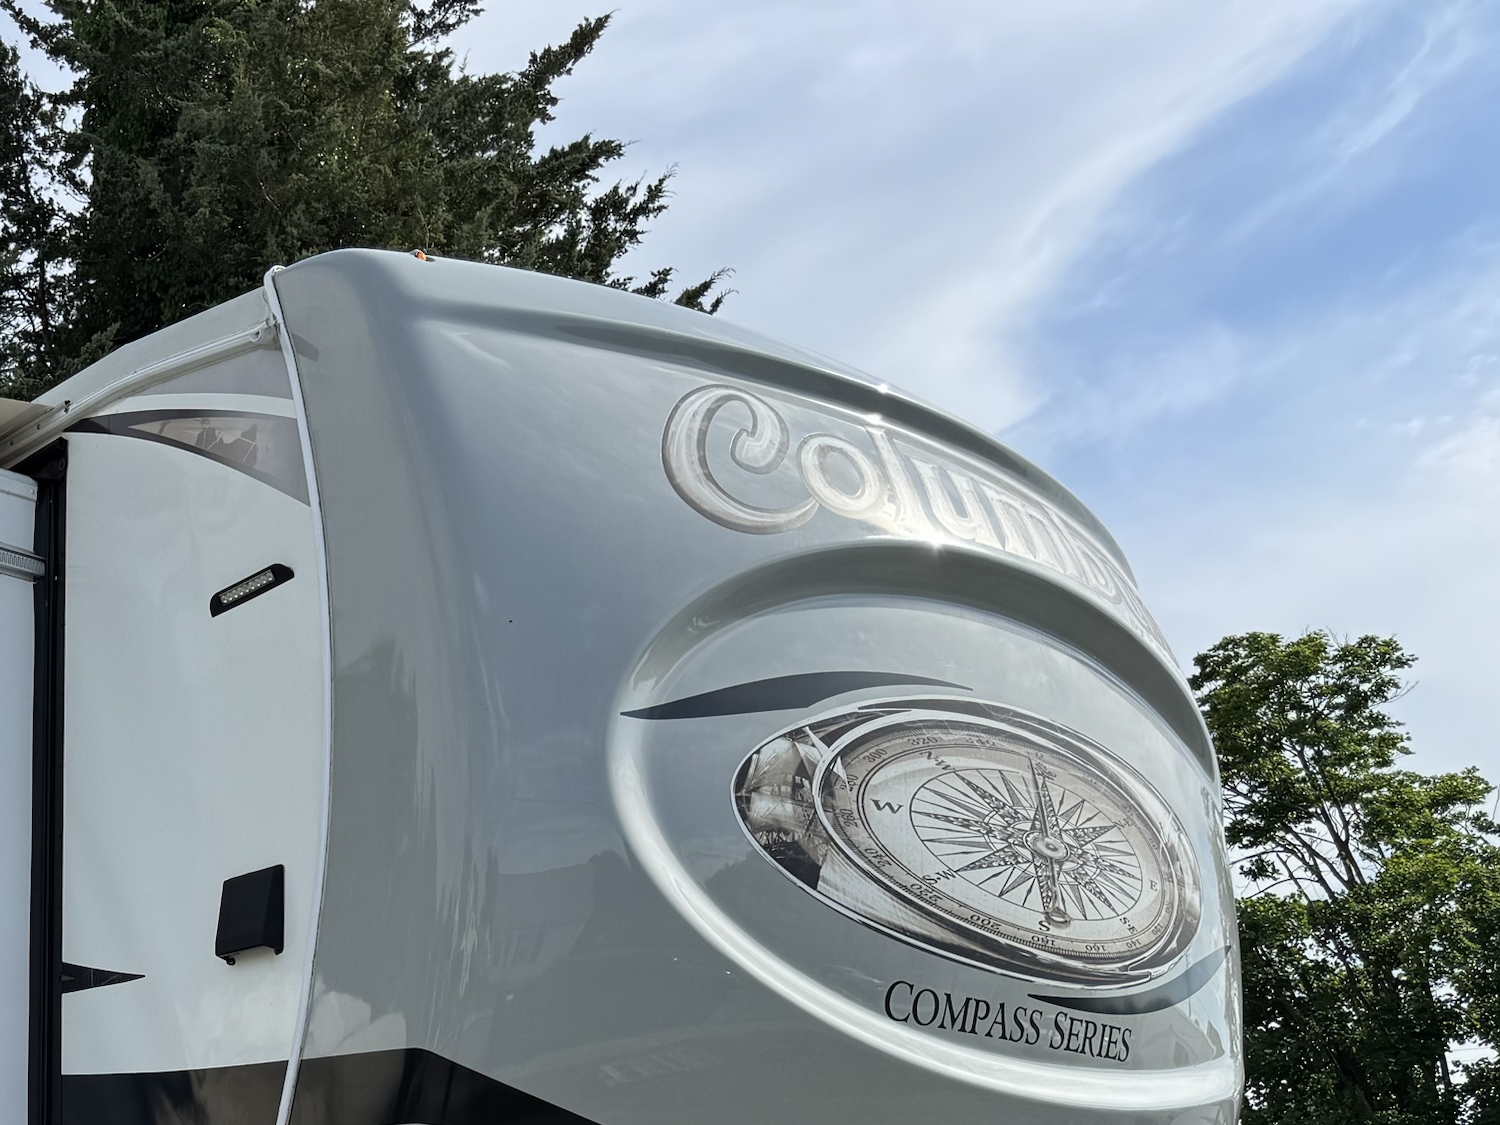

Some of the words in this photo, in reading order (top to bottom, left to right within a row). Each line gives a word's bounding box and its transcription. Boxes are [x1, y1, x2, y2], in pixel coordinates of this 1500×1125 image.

[661, 384, 1180, 668] Columb
[862, 748, 888, 764] 300
[870, 798, 904, 815] W
[883, 980, 1044, 1046] COMPASS
[1048, 1010, 1133, 1063] SERIES
